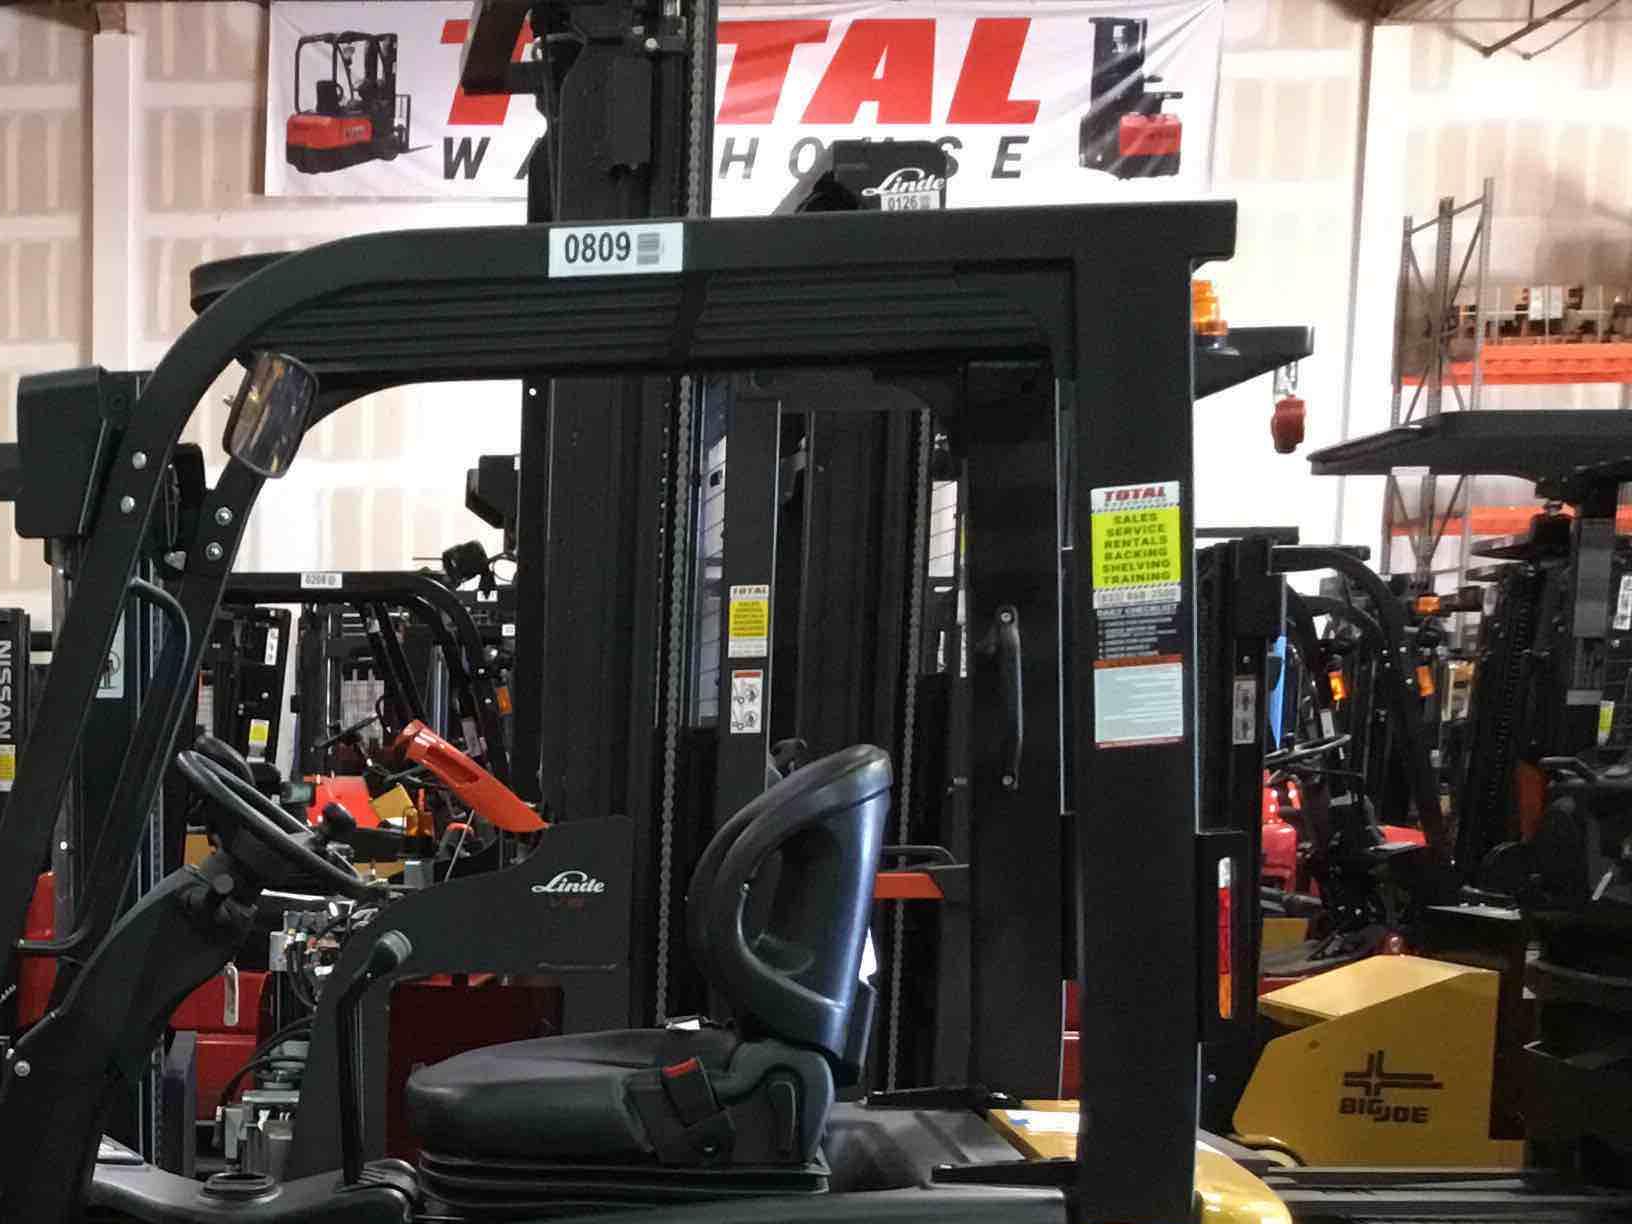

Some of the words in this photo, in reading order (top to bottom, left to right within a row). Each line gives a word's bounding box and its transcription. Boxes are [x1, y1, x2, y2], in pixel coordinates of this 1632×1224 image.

[861, 167, 945, 196] Linde
[565, 231, 631, 263] 0809
[1104, 486, 1167, 501] TOTAL
[1113, 512, 1158, 525] SALES
[1105, 523, 1166, 538] SERVICE
[1103, 535, 1168, 549] RENTALS
[1101, 558, 1171, 573] SHELVING
[1102, 571, 1171, 585] TRAINING
[531, 870, 605, 892] Linde
